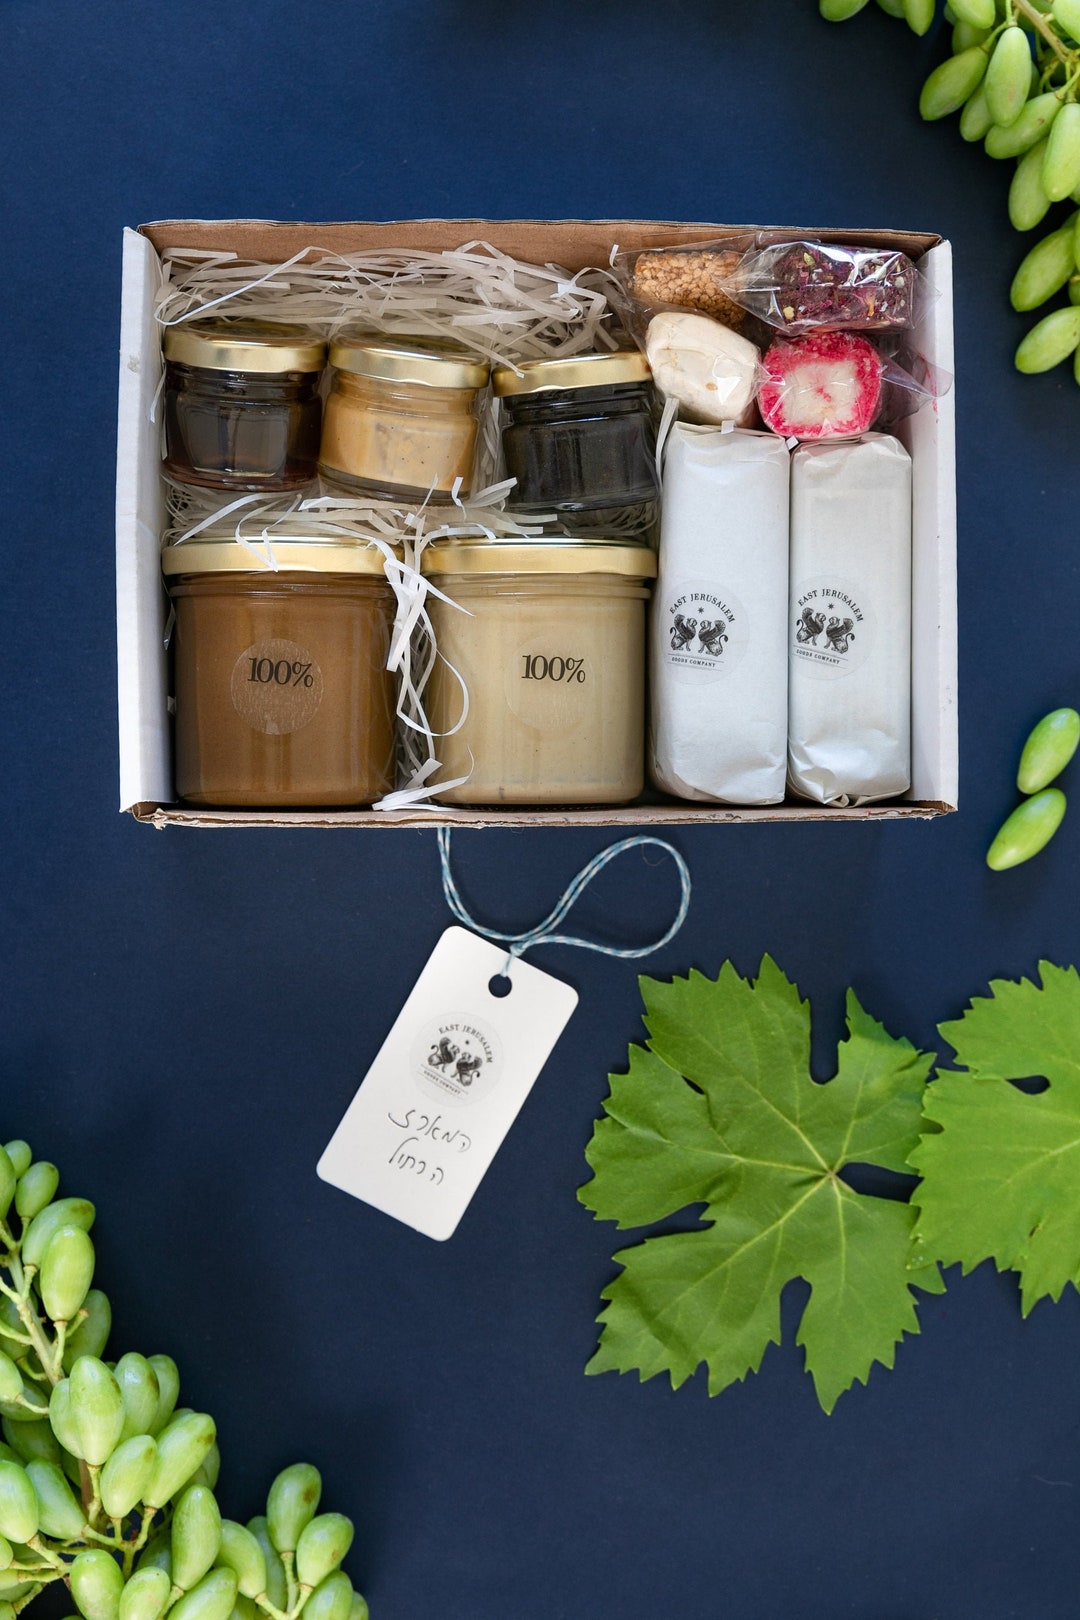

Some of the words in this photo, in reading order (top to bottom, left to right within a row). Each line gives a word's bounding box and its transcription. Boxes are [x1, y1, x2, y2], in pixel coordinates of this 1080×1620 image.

[669, 595, 687, 615] EAST
[690, 593, 736, 623] JERUSALEM
[797, 589, 818, 607] EAST
[821, 588, 864, 622] JERUSALEM
[247, 657, 314, 688] 100%
[521, 654, 586, 683] 100%
[689, 659, 716, 668] COMPANY
[438, 1023, 460, 1035] EAST
[462, 1024, 494, 1064] JERUSALEM
